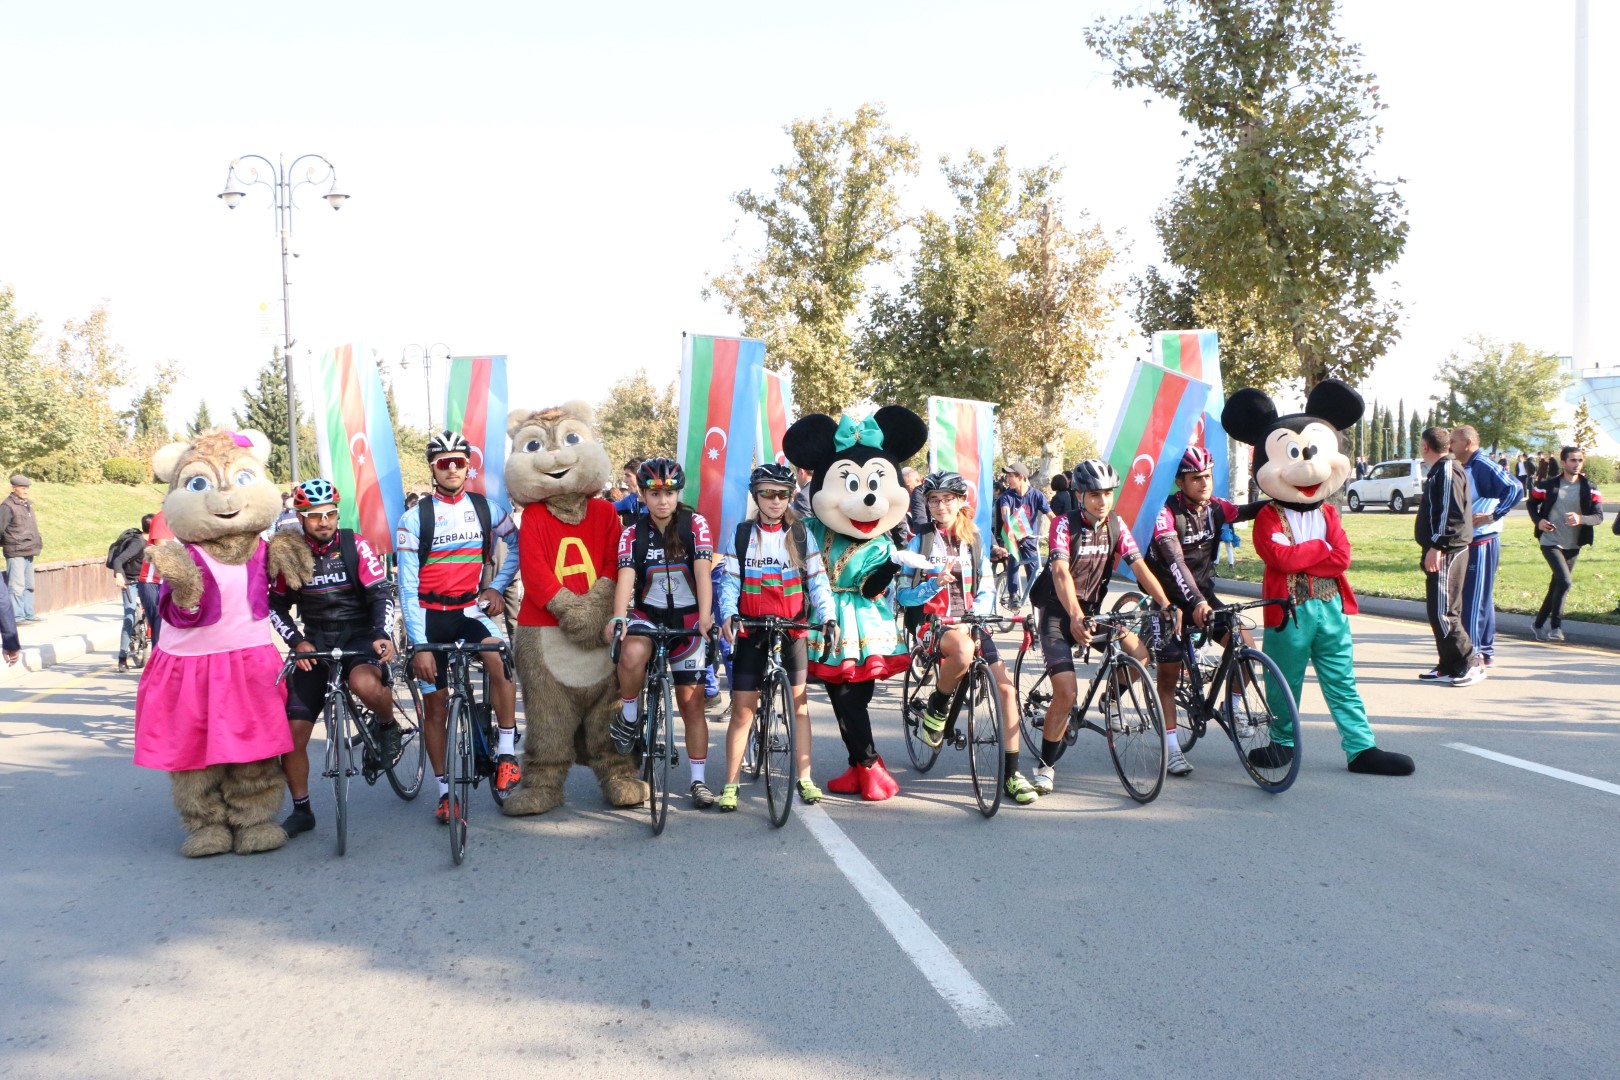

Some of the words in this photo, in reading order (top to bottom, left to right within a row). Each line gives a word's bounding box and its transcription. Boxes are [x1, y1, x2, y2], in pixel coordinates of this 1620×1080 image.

[432, 530, 484, 545] ZERBAIJAN
[692, 513, 710, 542] AKU
[356, 539, 384, 577] AKU
[554, 536, 598, 591] A
[1170, 562, 1195, 602] BAKU
